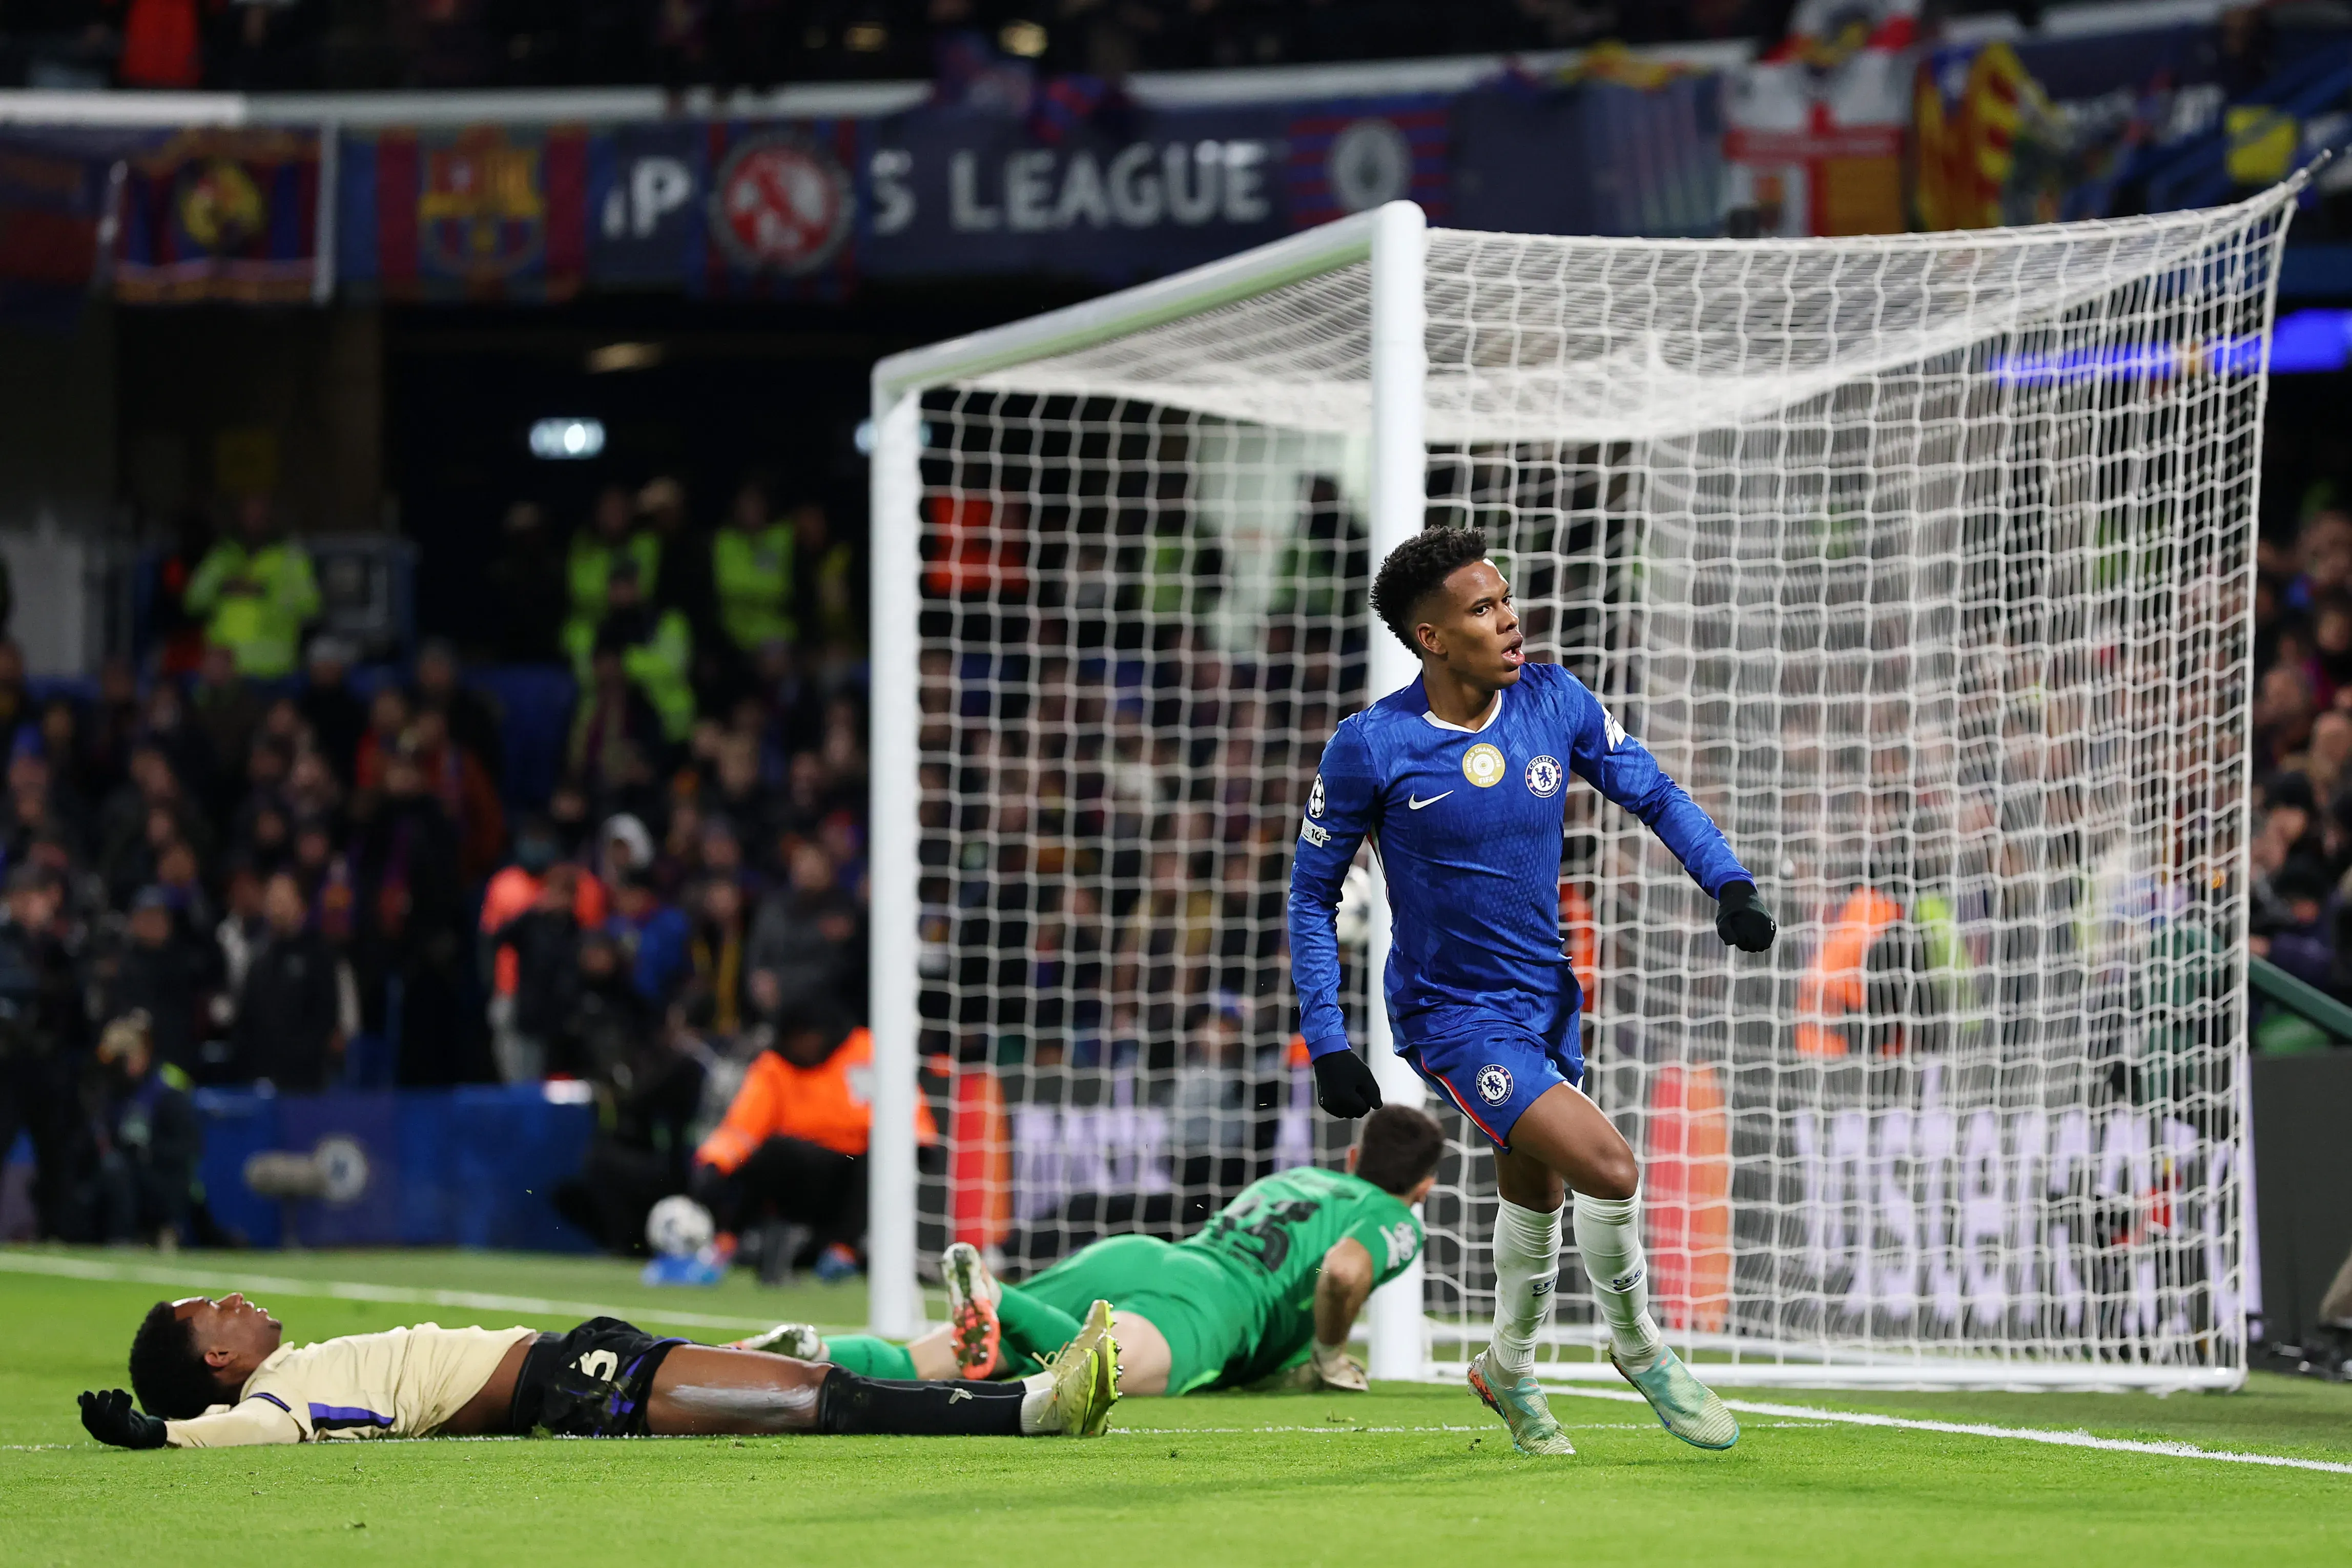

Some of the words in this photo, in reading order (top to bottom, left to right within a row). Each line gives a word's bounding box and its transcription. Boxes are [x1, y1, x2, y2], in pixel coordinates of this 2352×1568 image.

[948, 138, 1270, 233] LEAGUE
[1467, 752, 1475, 773] WORLD
[1475, 747, 1501, 767] CHAMPIONS
[1529, 757, 1552, 770] CHELSEA
[1478, 776, 1495, 784] FIFA
[1478, 1066, 1494, 1086] CHELSEA
[1613, 1269, 1642, 1285] CFC
